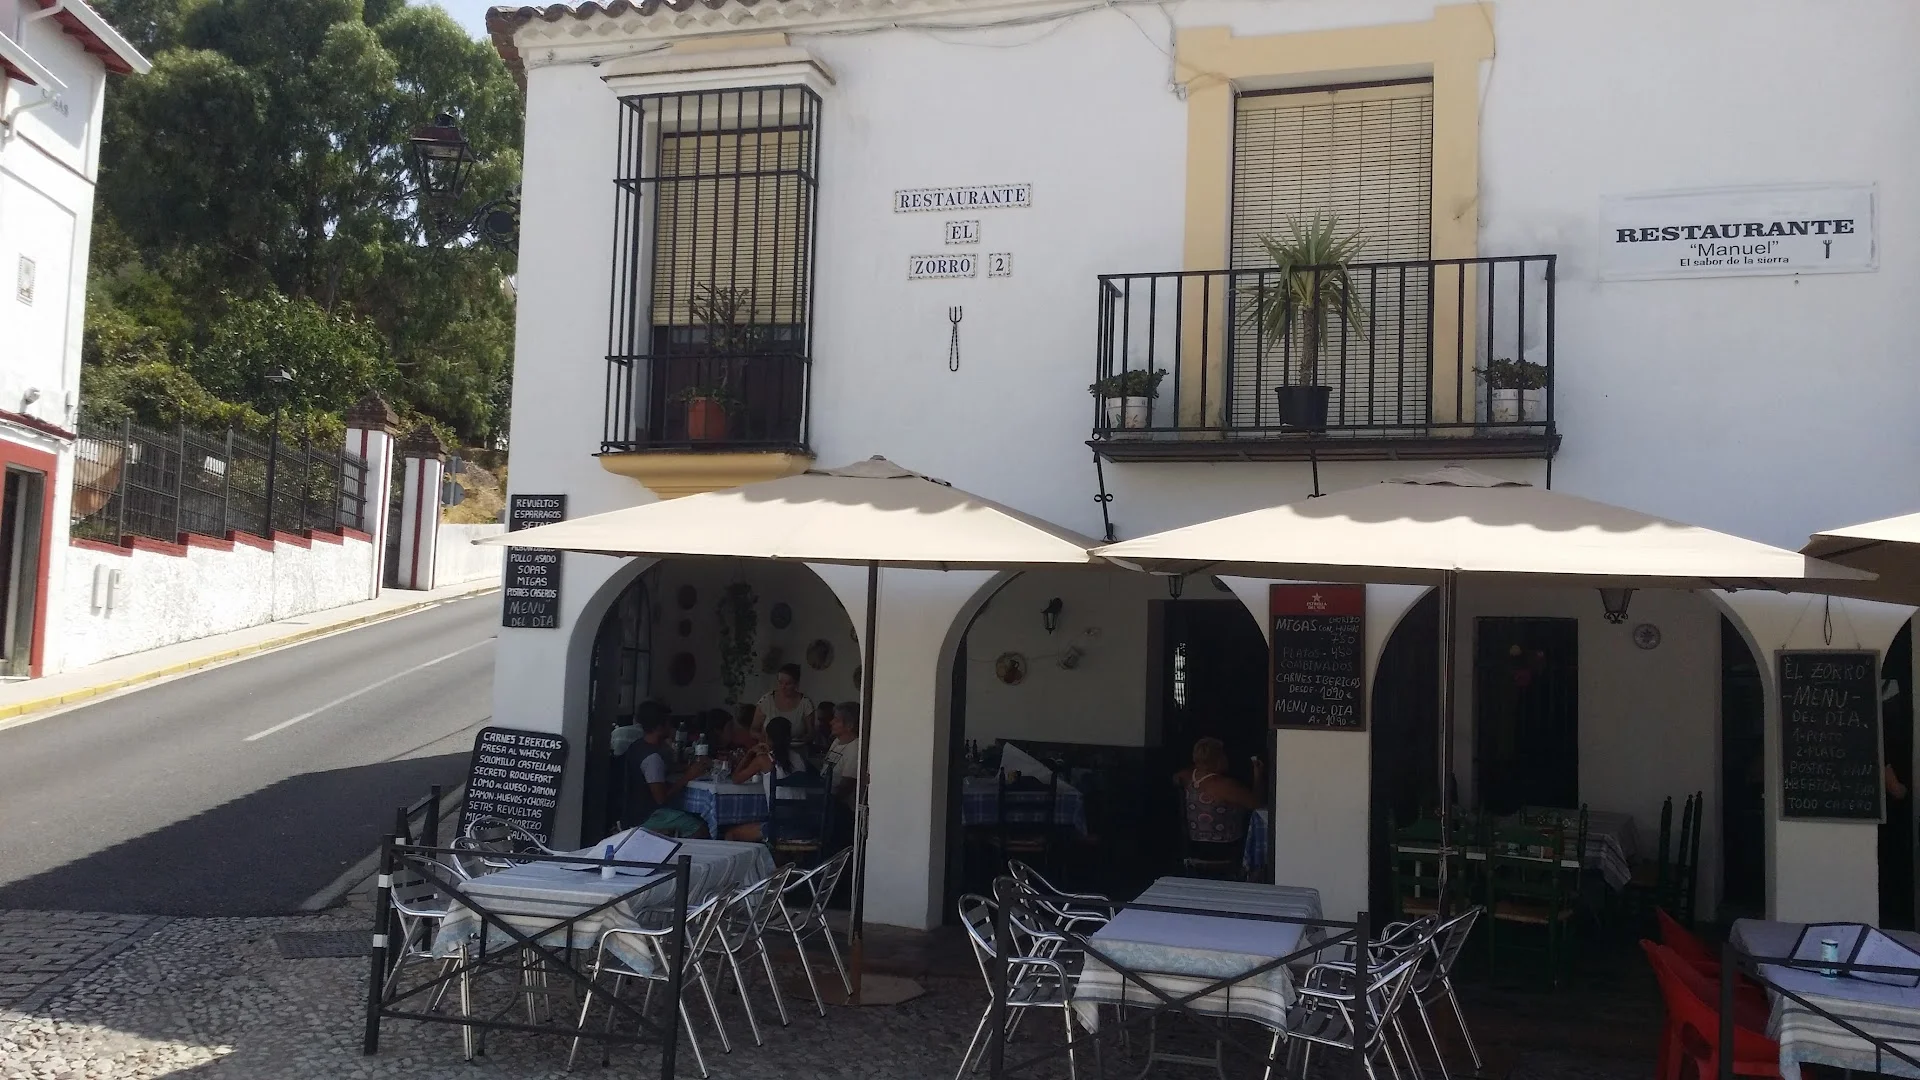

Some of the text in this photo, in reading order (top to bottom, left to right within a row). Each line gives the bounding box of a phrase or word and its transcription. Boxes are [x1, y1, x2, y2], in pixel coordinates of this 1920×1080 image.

[900, 188, 1025, 208] RESTAURANTE
[951, 225, 973, 239] EL
[1615, 219, 1854, 243] RESTAURANTE
[1690, 241, 1779, 257] "Manuel"
[915, 258, 1004, 275] ZORRO 2
[1680, 256, 1789, 267] El sabor de la sierra
[516, 499, 560, 508] REVUELTOS
[514, 509, 562, 518] ESPARRAGOS
[510, 554, 557, 564] POLLO ASADO
[517, 565, 547, 574] SOPAS
[516, 577, 548, 586] MIGAS
[511, 615, 554, 627] DEL DIA
[1275, 618, 1318, 632] MIGAS
[1283, 646, 1319, 659] PLATOS
[1280, 660, 1353, 672] COMBINADOS
[1276, 672, 1360, 688] CARNES IBERICAS
[1289, 684, 1314, 693] DESDE
[1275, 698, 1353, 716] MENU DEL DIA
[1792, 709, 1816, 722] DEL
[483, 732, 562, 750] CARNES IBERICAS
[481, 743, 552, 760] PRESA AL WHISKY
[479, 754, 562, 773] SOLOMILLO CASTELLANA
[474, 766, 554, 784] SECRETO ROQUEFORT
[472, 778, 495, 789] LOMO
[502, 782, 527, 792] QUESO
[531, 786, 557, 797] JAMON
[496, 792, 524, 804] HUEVOS
[527, 796, 556, 808] CHORIZO
[1788, 797, 1818, 809] TODO
[468, 800, 543, 819] SETAS REVUELTAS
